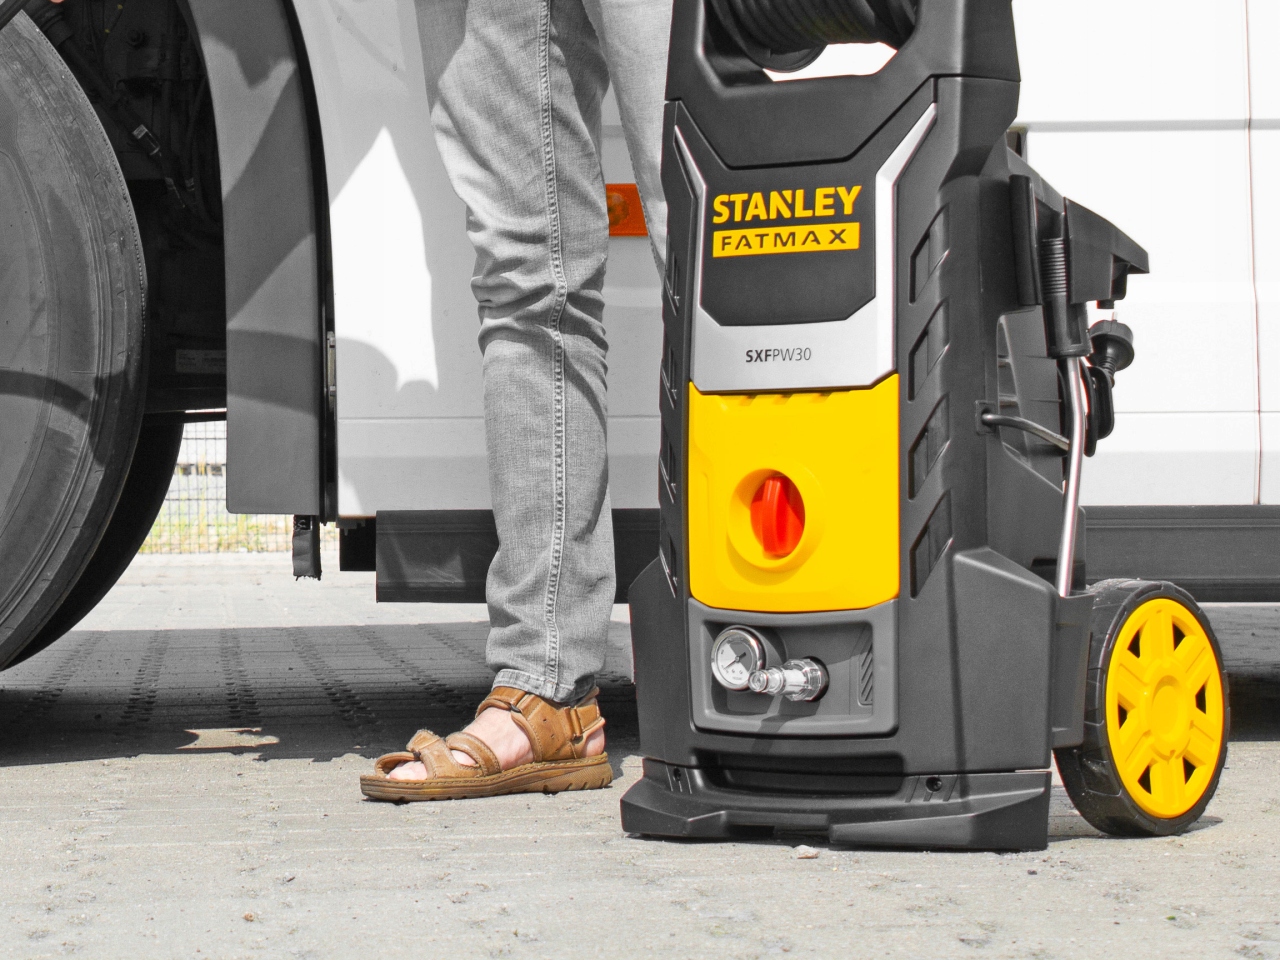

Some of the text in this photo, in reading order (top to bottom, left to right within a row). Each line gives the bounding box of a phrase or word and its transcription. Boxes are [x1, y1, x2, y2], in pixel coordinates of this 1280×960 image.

[712, 185, 862, 224] STANLEY
[721, 228, 847, 252] FATMAX
[745, 347, 812, 363] SXFPW30
